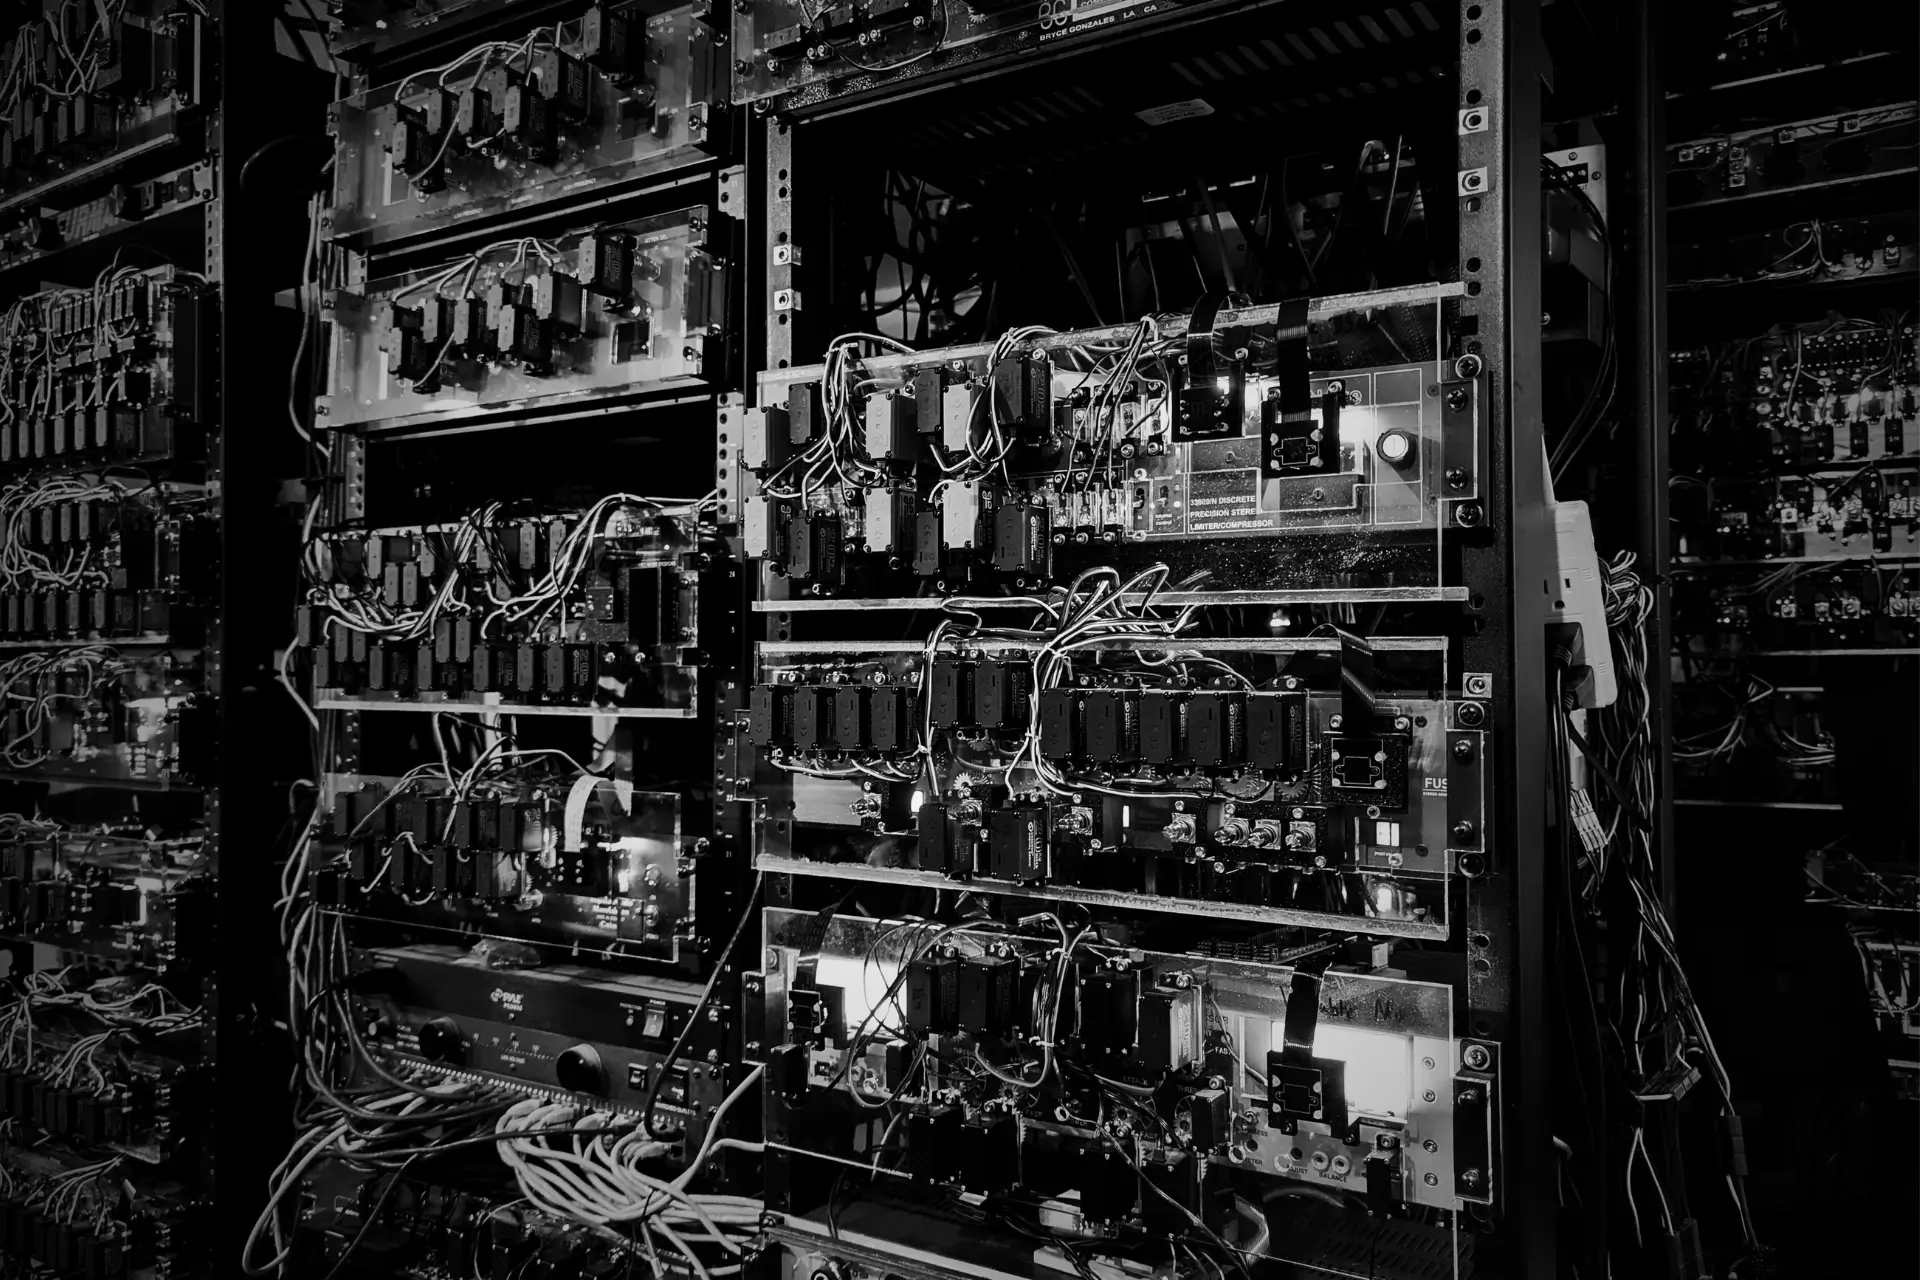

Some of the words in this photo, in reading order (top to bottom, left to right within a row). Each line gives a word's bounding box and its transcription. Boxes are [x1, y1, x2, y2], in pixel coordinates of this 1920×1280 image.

[1040, 28, 1067, 41] BRYCE
[1069, 15, 1115, 33] GONZALES
[1123, 10, 1136, 19] LA
[1144, 4, 1157, 13] CA
[1190, 508, 1230, 518] PRECISION
[1231, 508, 1257, 516] STERE
[1190, 520, 1274, 530] LIMITER/COMPRESSOR
[1319, 1171, 1348, 1183] BALANCE
